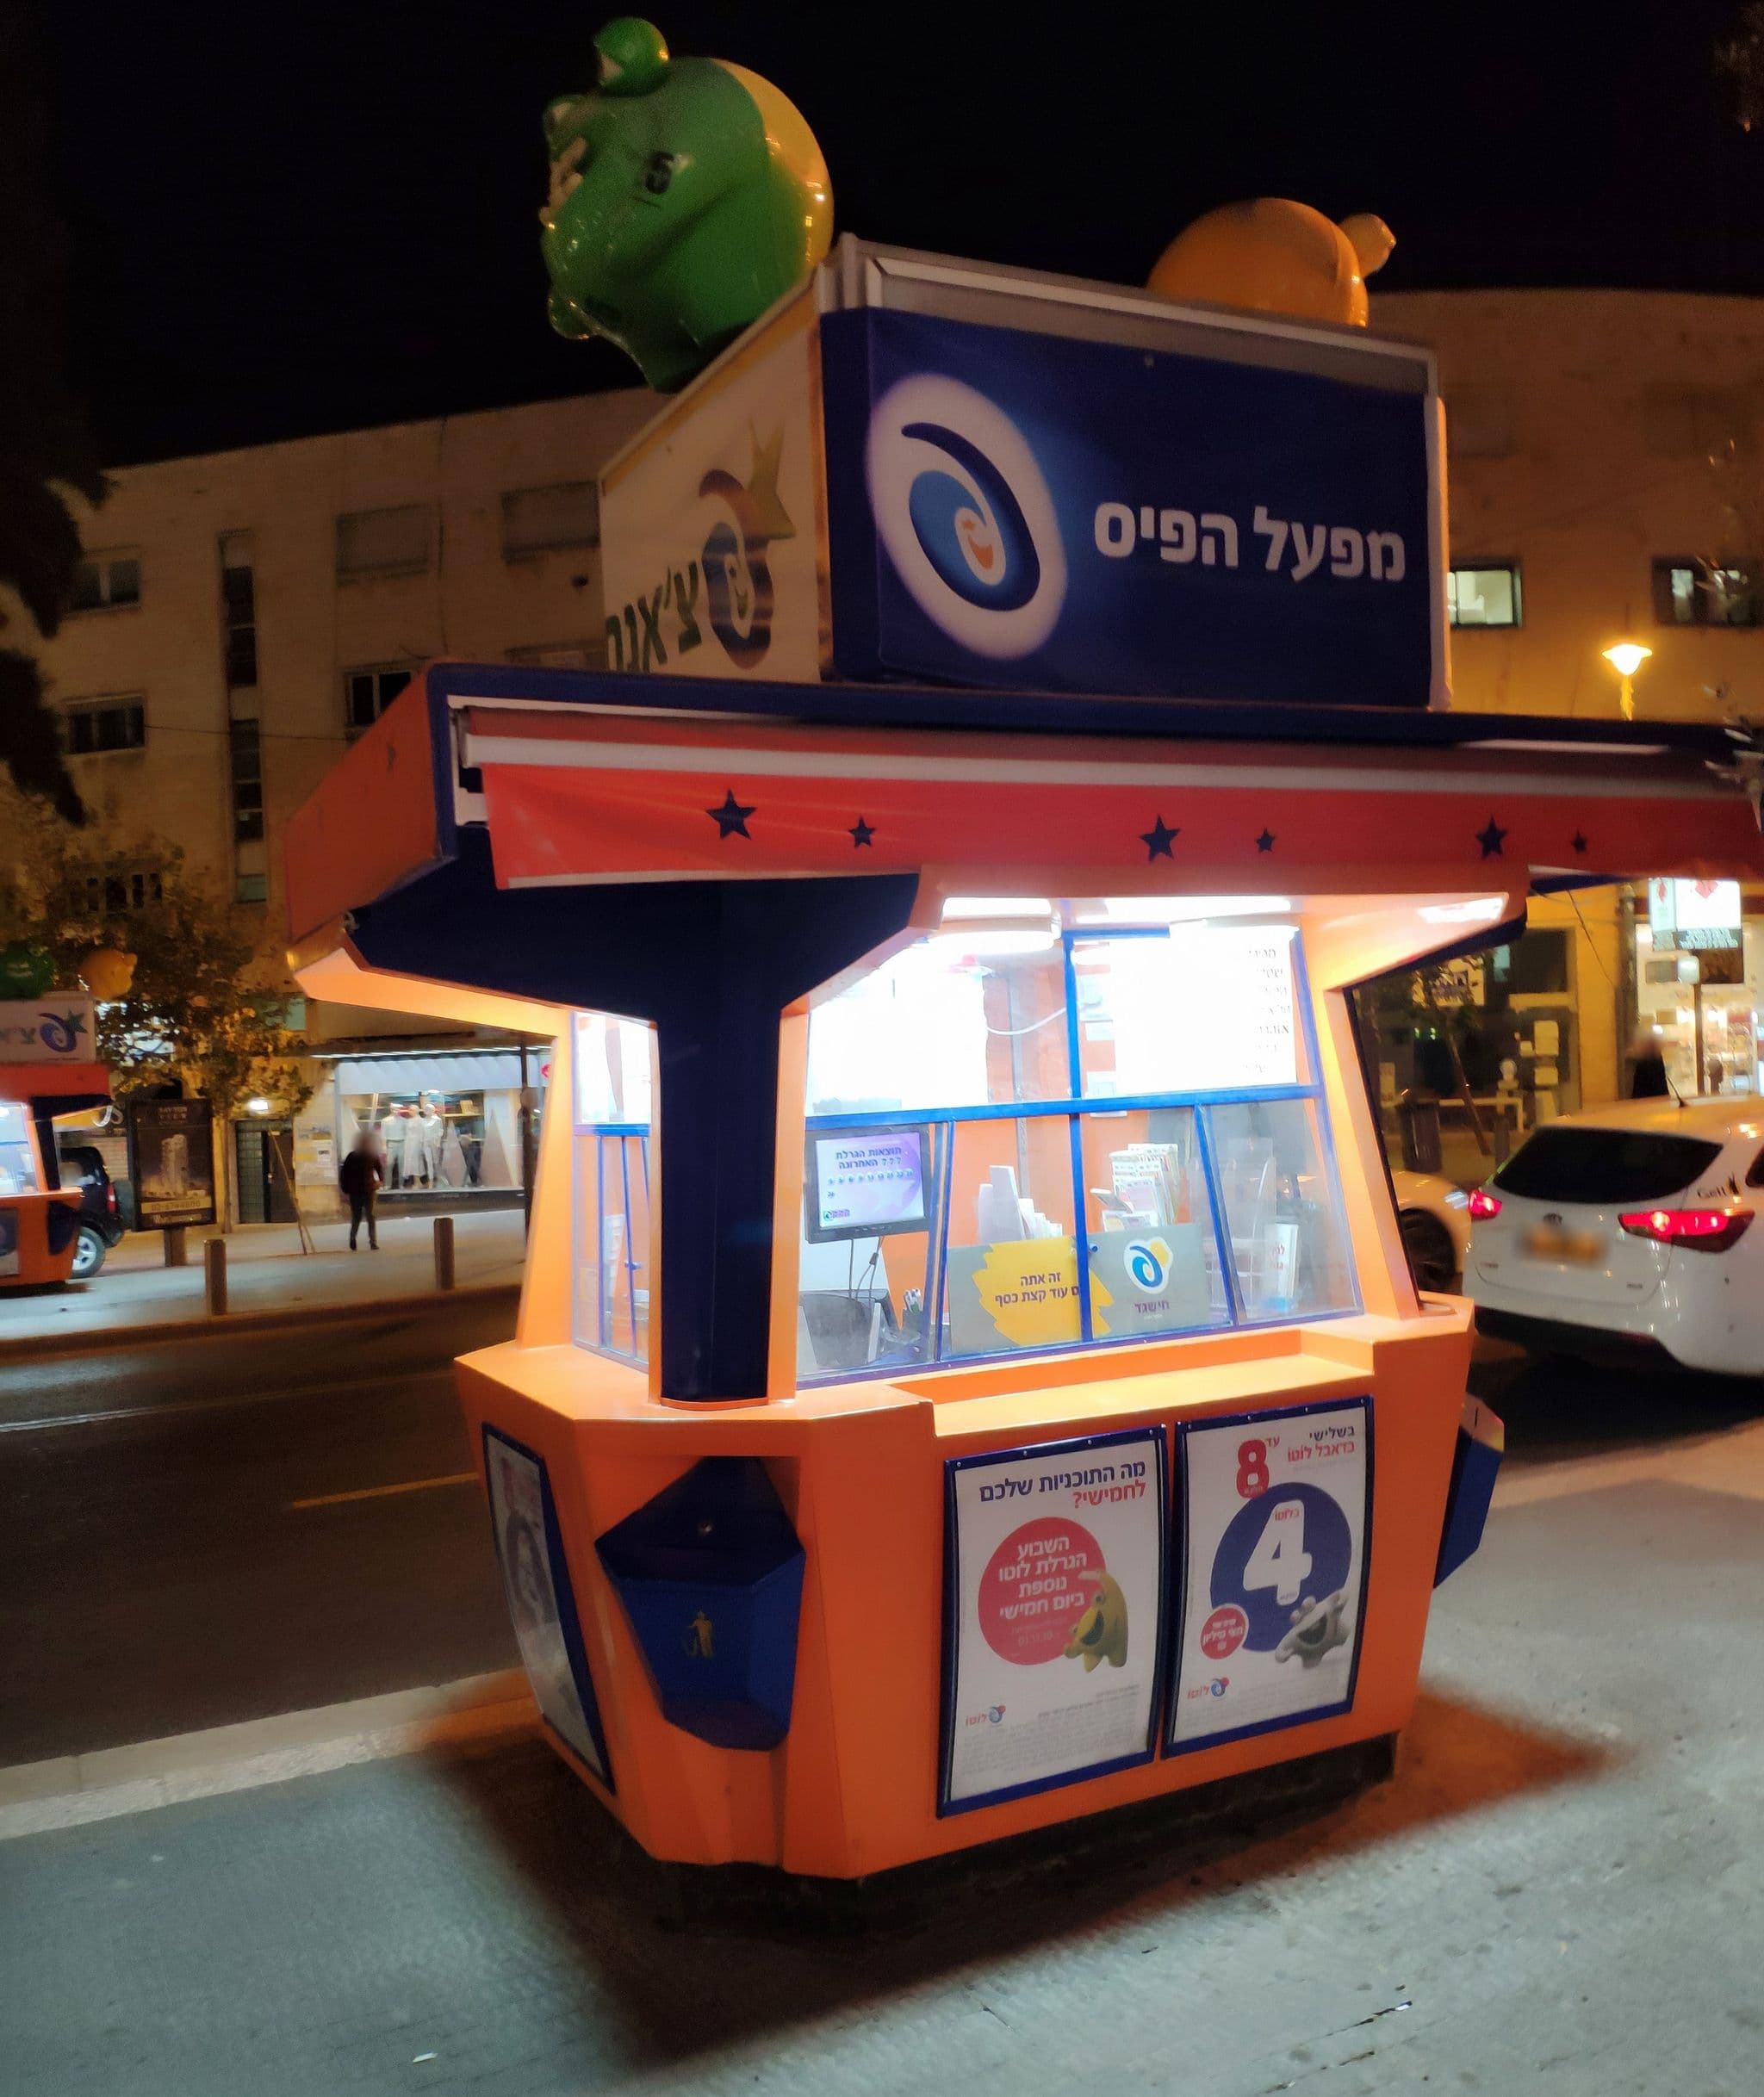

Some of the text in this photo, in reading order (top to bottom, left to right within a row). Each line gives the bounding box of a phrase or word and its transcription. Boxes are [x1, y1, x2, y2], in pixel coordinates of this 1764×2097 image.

[1095, 501, 1406, 583] מפעל הפיס
[1020, 1271, 1061, 1287] זה אתה
[994, 1292, 1019, 1308] כסף
[1021, 1289, 1046, 1303] קצת
[1049, 1287, 1068, 1300] עוד
[1267, 1436, 1281, 1449] עד
[1309, 1424, 1355, 1442] בשלישי
[1236, 1439, 1270, 1498] 8
[979, 1461, 1146, 1502] מה התוכניות שלכם
[1073, 1479, 1146, 1509] לחמישי?
[1017, 1536, 1070, 1561] השבוע
[1243, 1499, 1313, 1605] 4
[998, 1553, 1088, 1583] הגרלת לוטו
[1018, 1576, 1068, 1599] נוספת
[999, 1592, 1085, 1620] ביום חמישי
